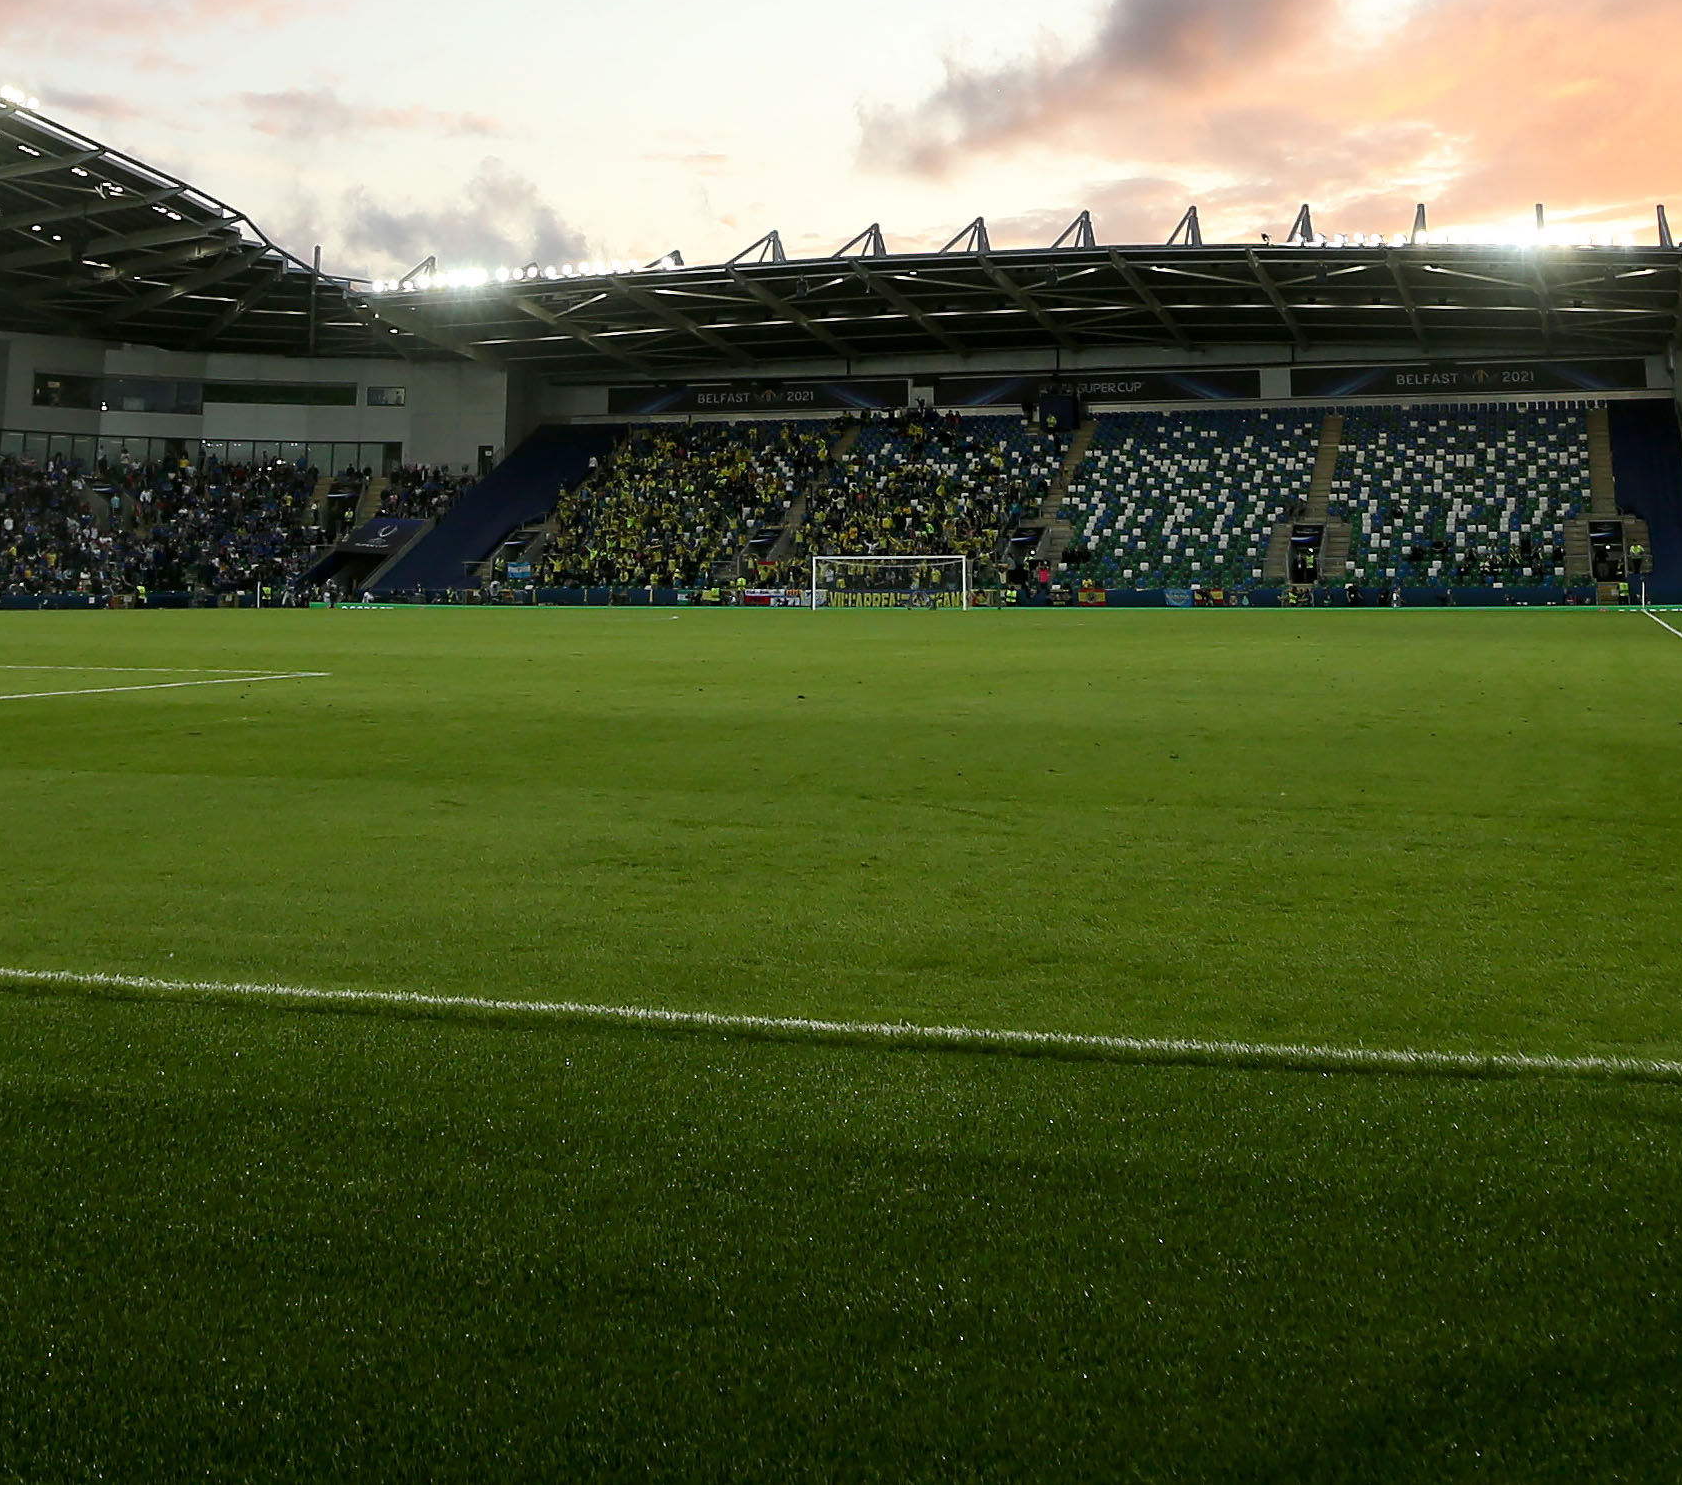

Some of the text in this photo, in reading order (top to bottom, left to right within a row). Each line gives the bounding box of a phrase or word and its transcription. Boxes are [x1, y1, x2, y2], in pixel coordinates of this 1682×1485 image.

[1397, 370, 1534, 385] BELFAST 2021
[1117, 381, 1143, 393] CUP
[697, 390, 814, 404] BELFAST 2021
